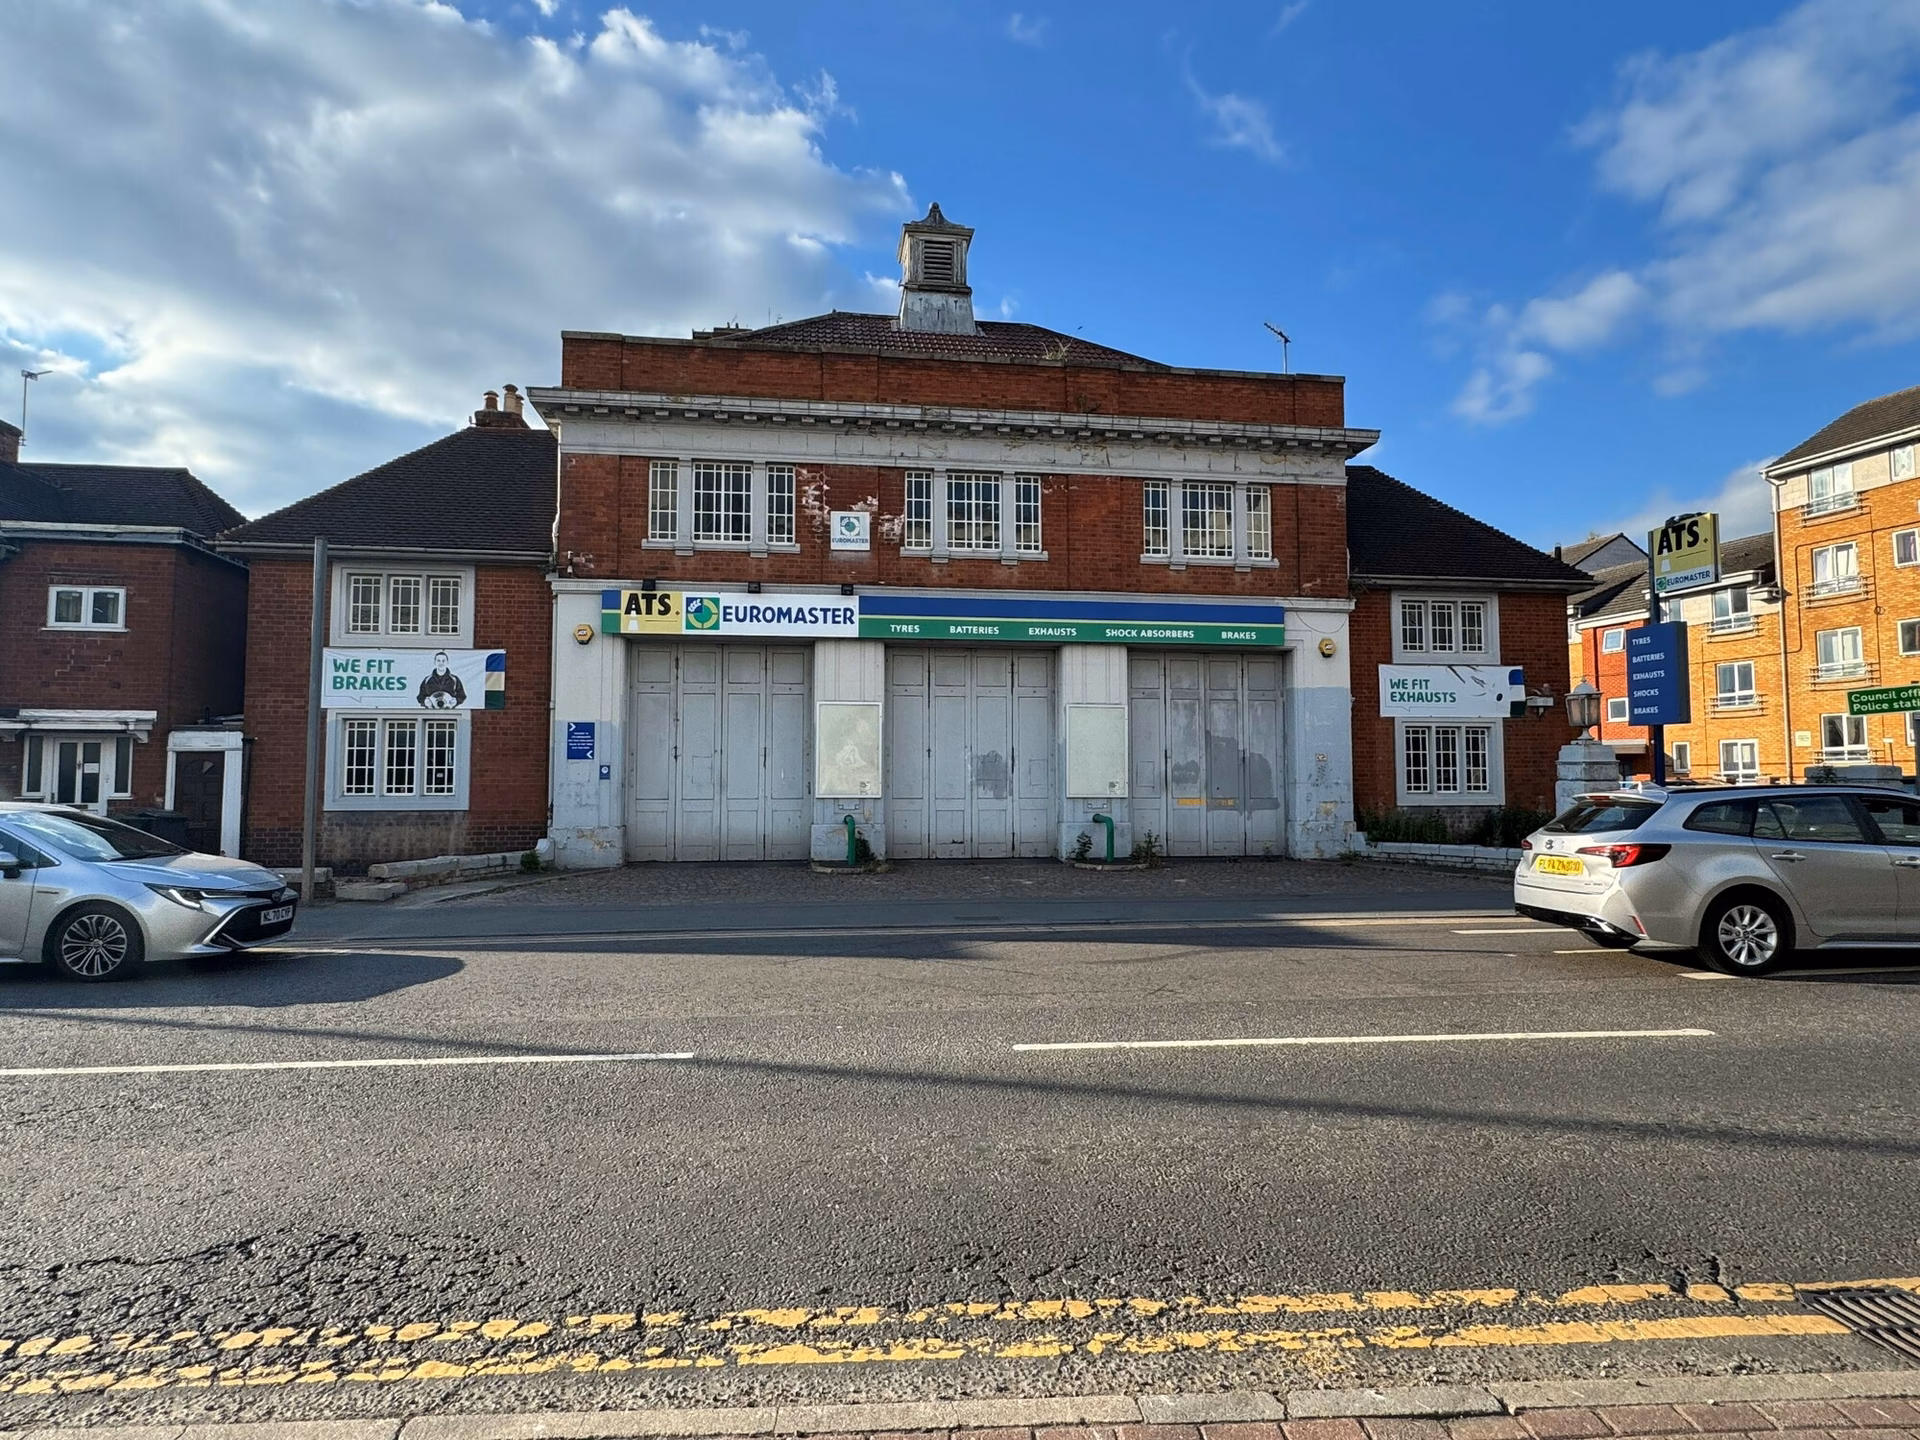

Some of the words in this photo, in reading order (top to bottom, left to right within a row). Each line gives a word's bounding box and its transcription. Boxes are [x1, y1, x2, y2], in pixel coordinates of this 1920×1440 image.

[1667, 570, 1711, 586] EUROMASTER
[722, 605, 855, 625] EUROMASTER
[890, 624, 920, 633] TYRES
[950, 626, 999, 635] BATTERIES
[1028, 627, 1077, 636] EXHAUSTS
[1105, 629, 1138, 637] SHOCK
[1140, 629, 1194, 638] ABSORBERS
[1221, 631, 1257, 640] BRAKES
[1632, 636, 1651, 645] TYRES
[1632, 652, 1665, 663] BATTERIES
[332, 658, 361, 673] WE
[366, 659, 395, 673] FIT
[1633, 670, 1665, 680] EXHAUSTS
[332, 675, 407, 690] BRAKES
[1389, 678, 1409, 690] WE
[1411, 679, 1430, 690] FIT
[1390, 691, 1457, 703] EXHAUSTS
[1633, 688, 1659, 697] SHOCKS
[1851, 690, 1898, 702] Council
[1633, 705, 1659, 715] BRAKES
[1853, 702, 1889, 712] Police
